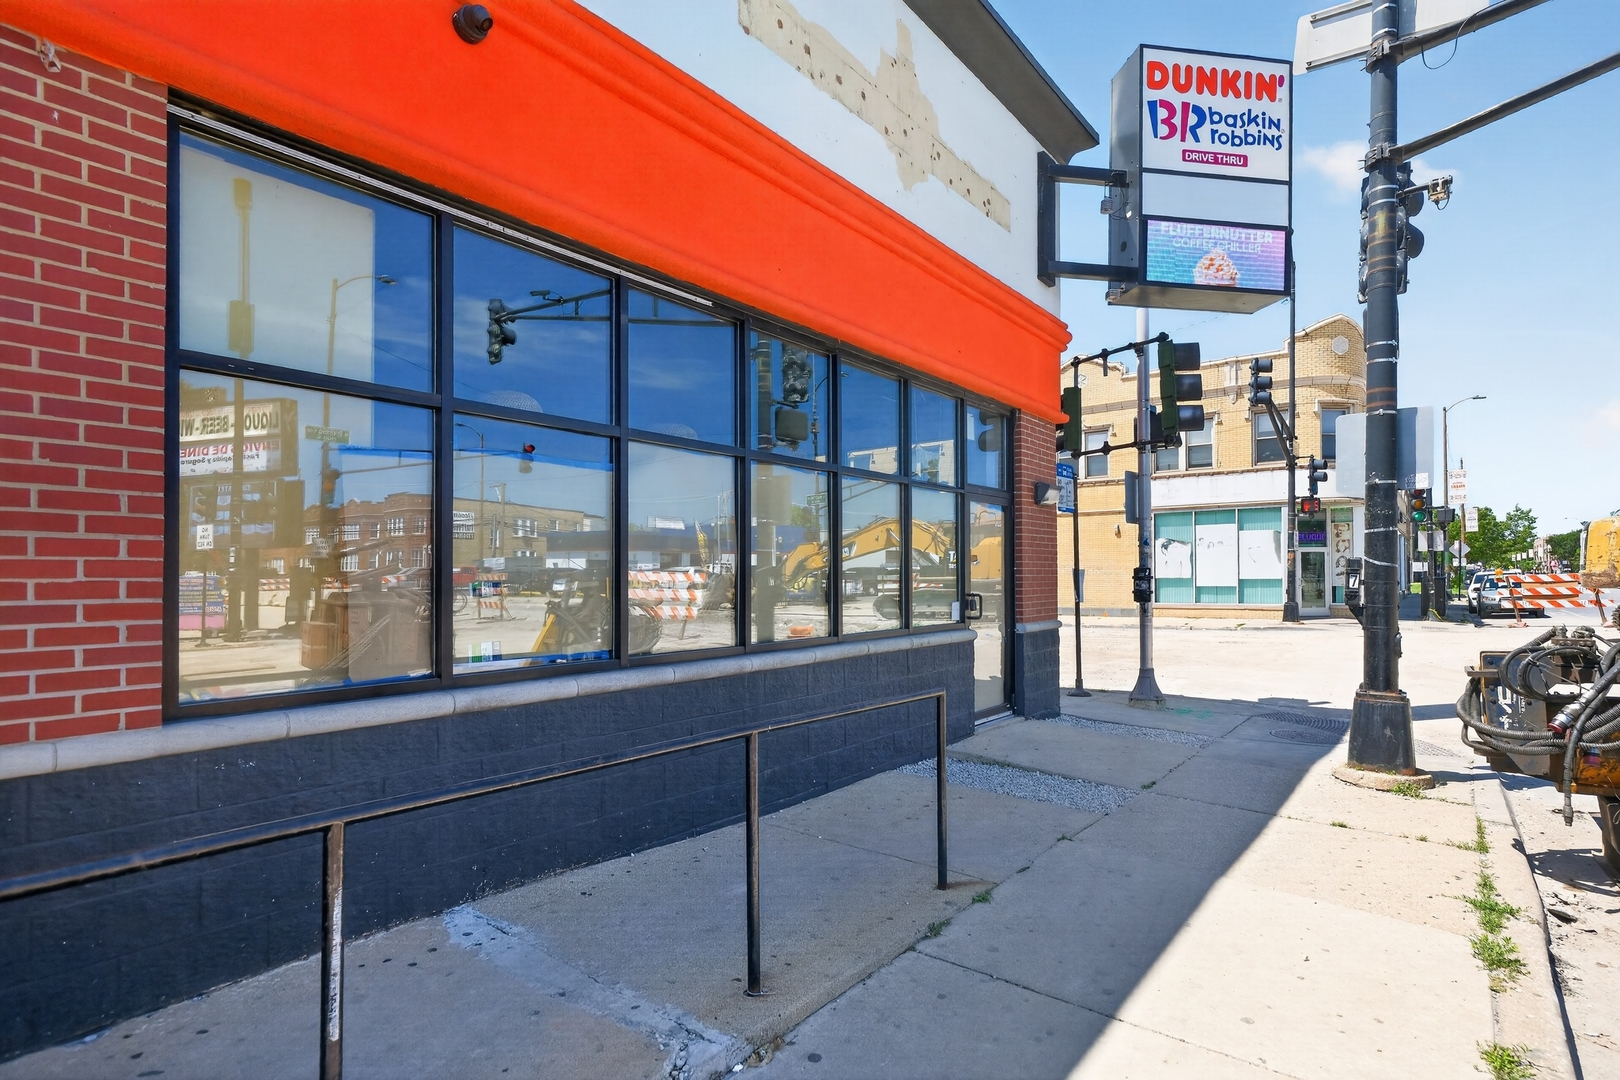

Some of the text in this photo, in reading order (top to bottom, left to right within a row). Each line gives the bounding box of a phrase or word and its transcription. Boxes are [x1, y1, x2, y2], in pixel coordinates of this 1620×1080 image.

[1146, 60, 1285, 103] DUNKIN'
[1185, 151, 1244, 165] DRIVE THRU
